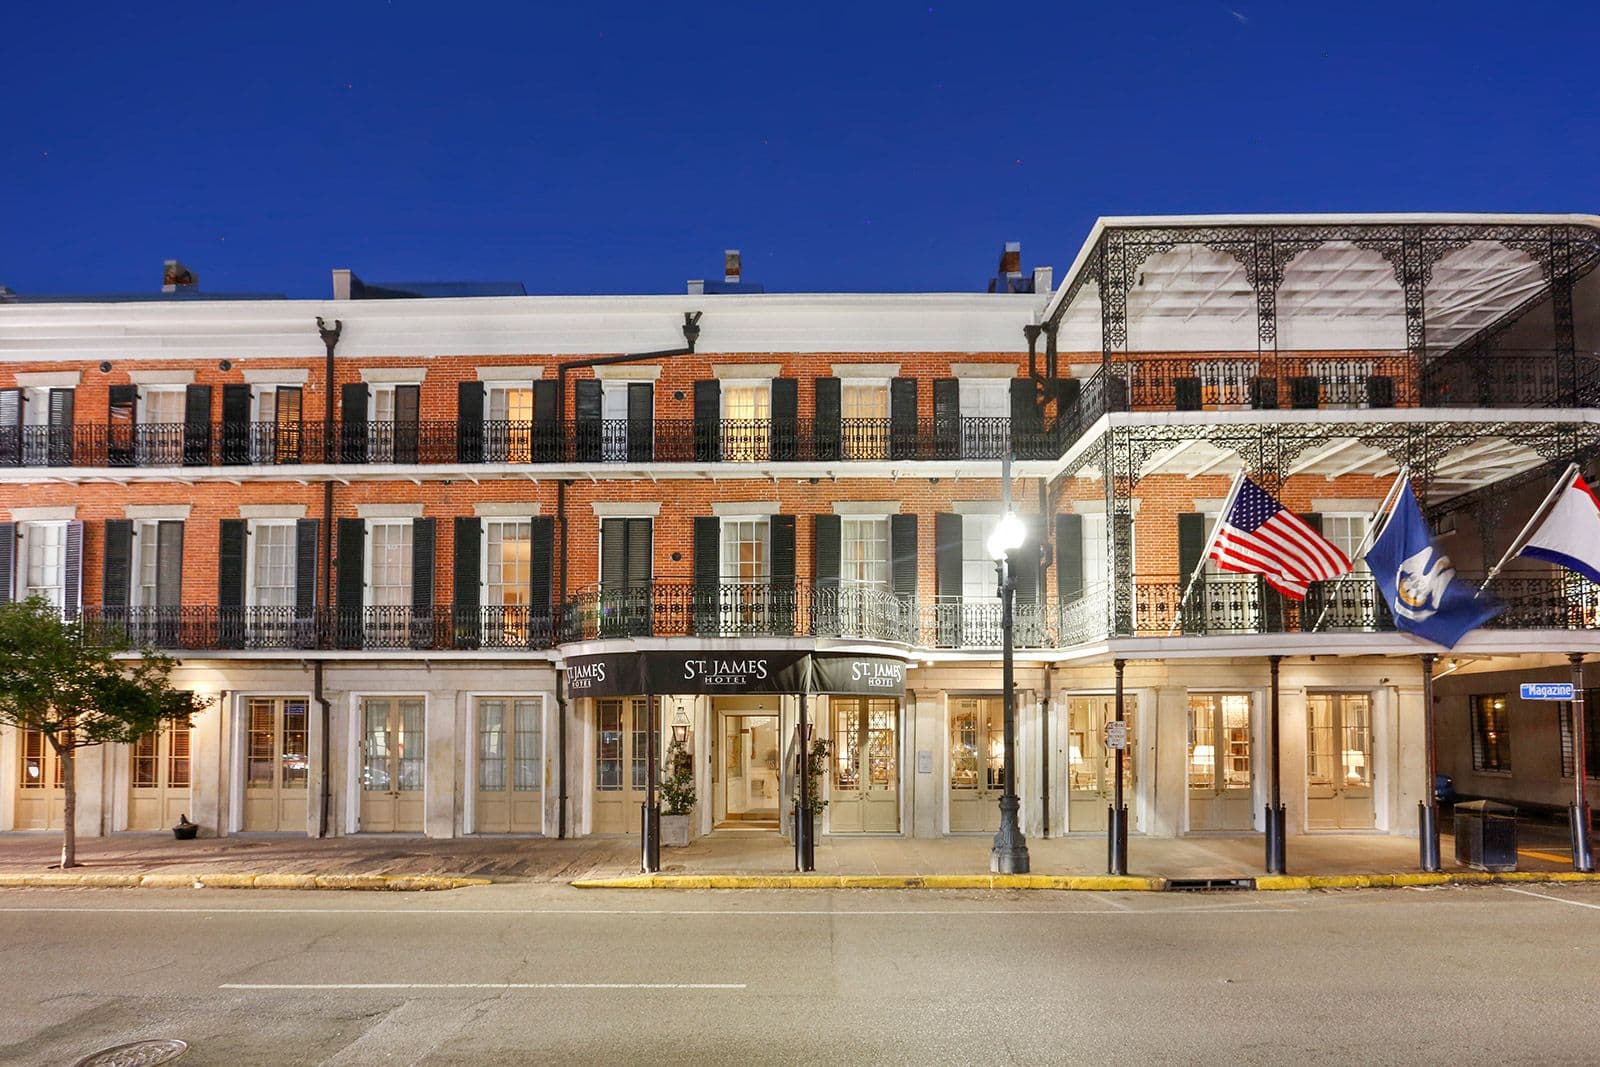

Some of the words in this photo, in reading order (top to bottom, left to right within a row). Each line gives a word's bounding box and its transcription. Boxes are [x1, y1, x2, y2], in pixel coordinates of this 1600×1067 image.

[573, 662, 605, 682] JAMES
[684, 660, 707, 679] ST.
[711, 660, 767, 679] JAMES
[852, 662, 870, 680] ST.
[873, 664, 901, 682] JAMES
[1529, 686, 1571, 698] Magazine
